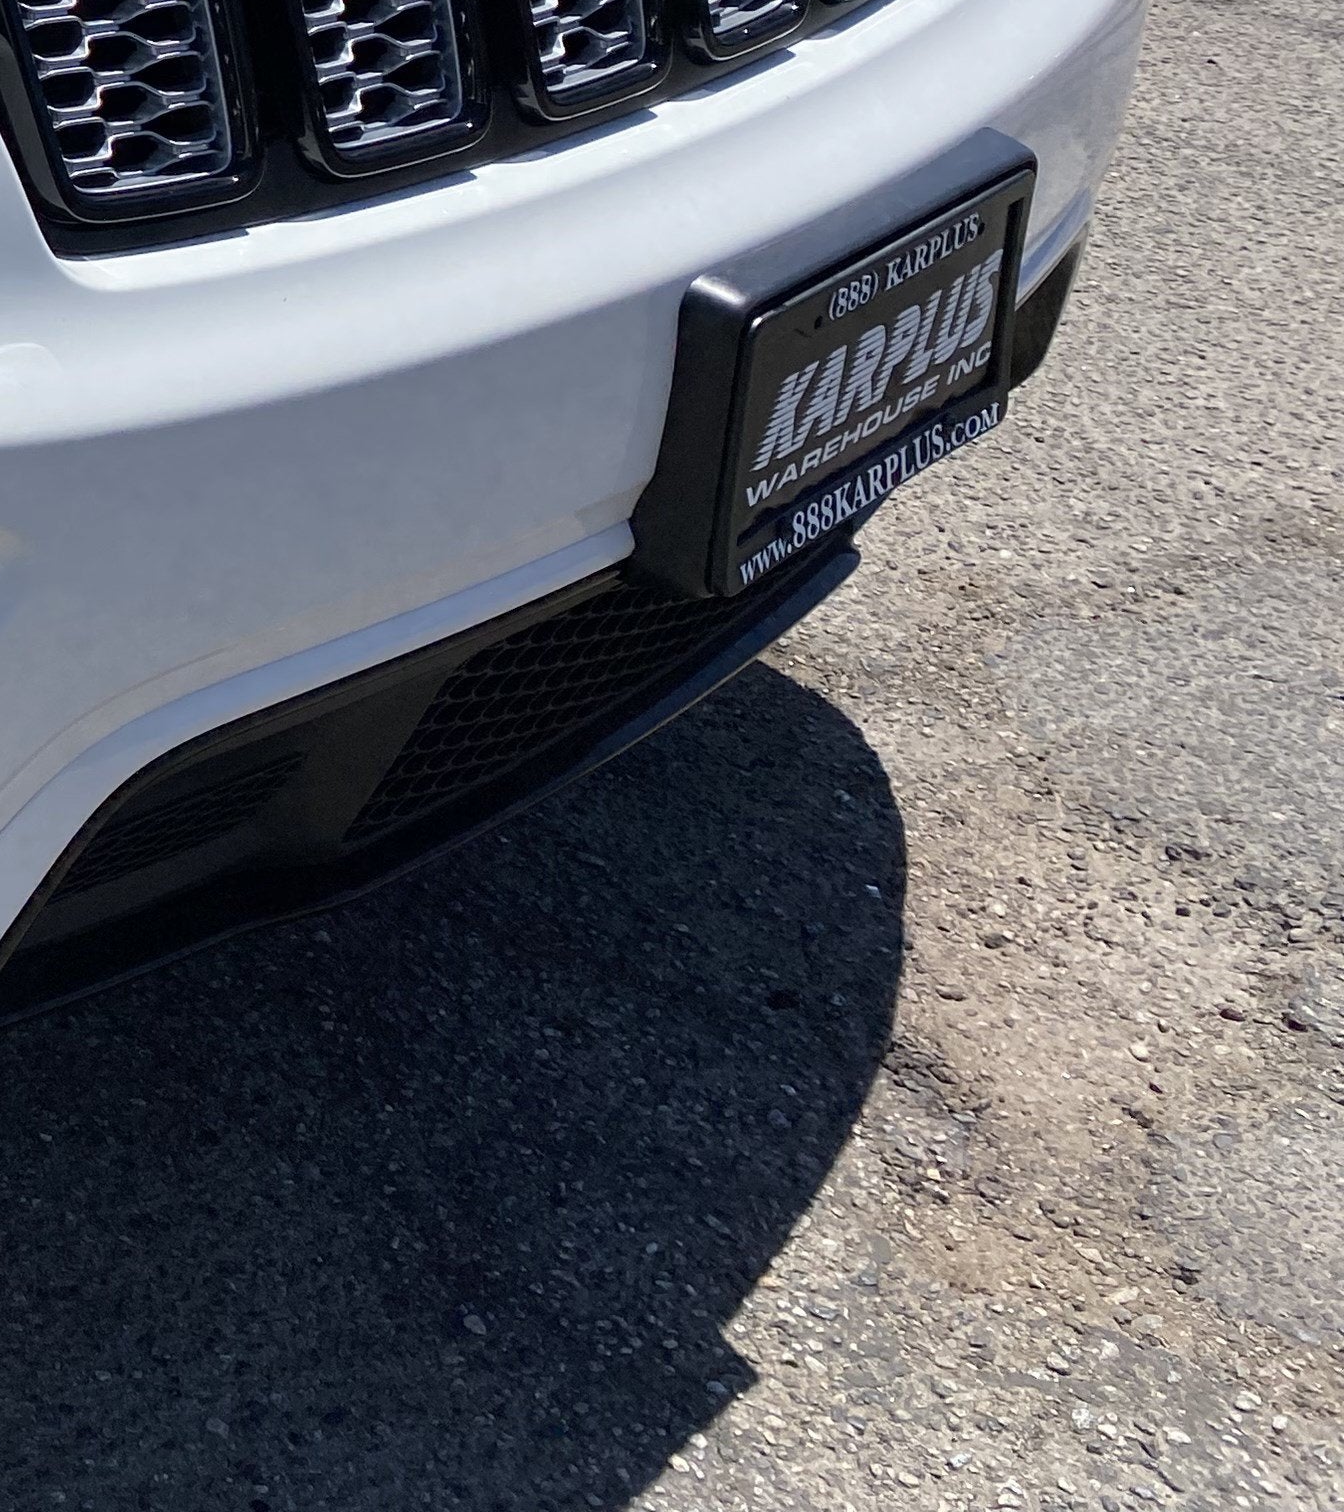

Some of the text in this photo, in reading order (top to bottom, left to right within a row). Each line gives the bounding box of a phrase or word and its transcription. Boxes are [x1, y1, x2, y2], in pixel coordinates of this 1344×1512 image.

[828, 212, 980, 321] (888) KARPLUS
[746, 341, 993, 508] WAREHOUSE INC
[749, 249, 1004, 473] KARPLUS
